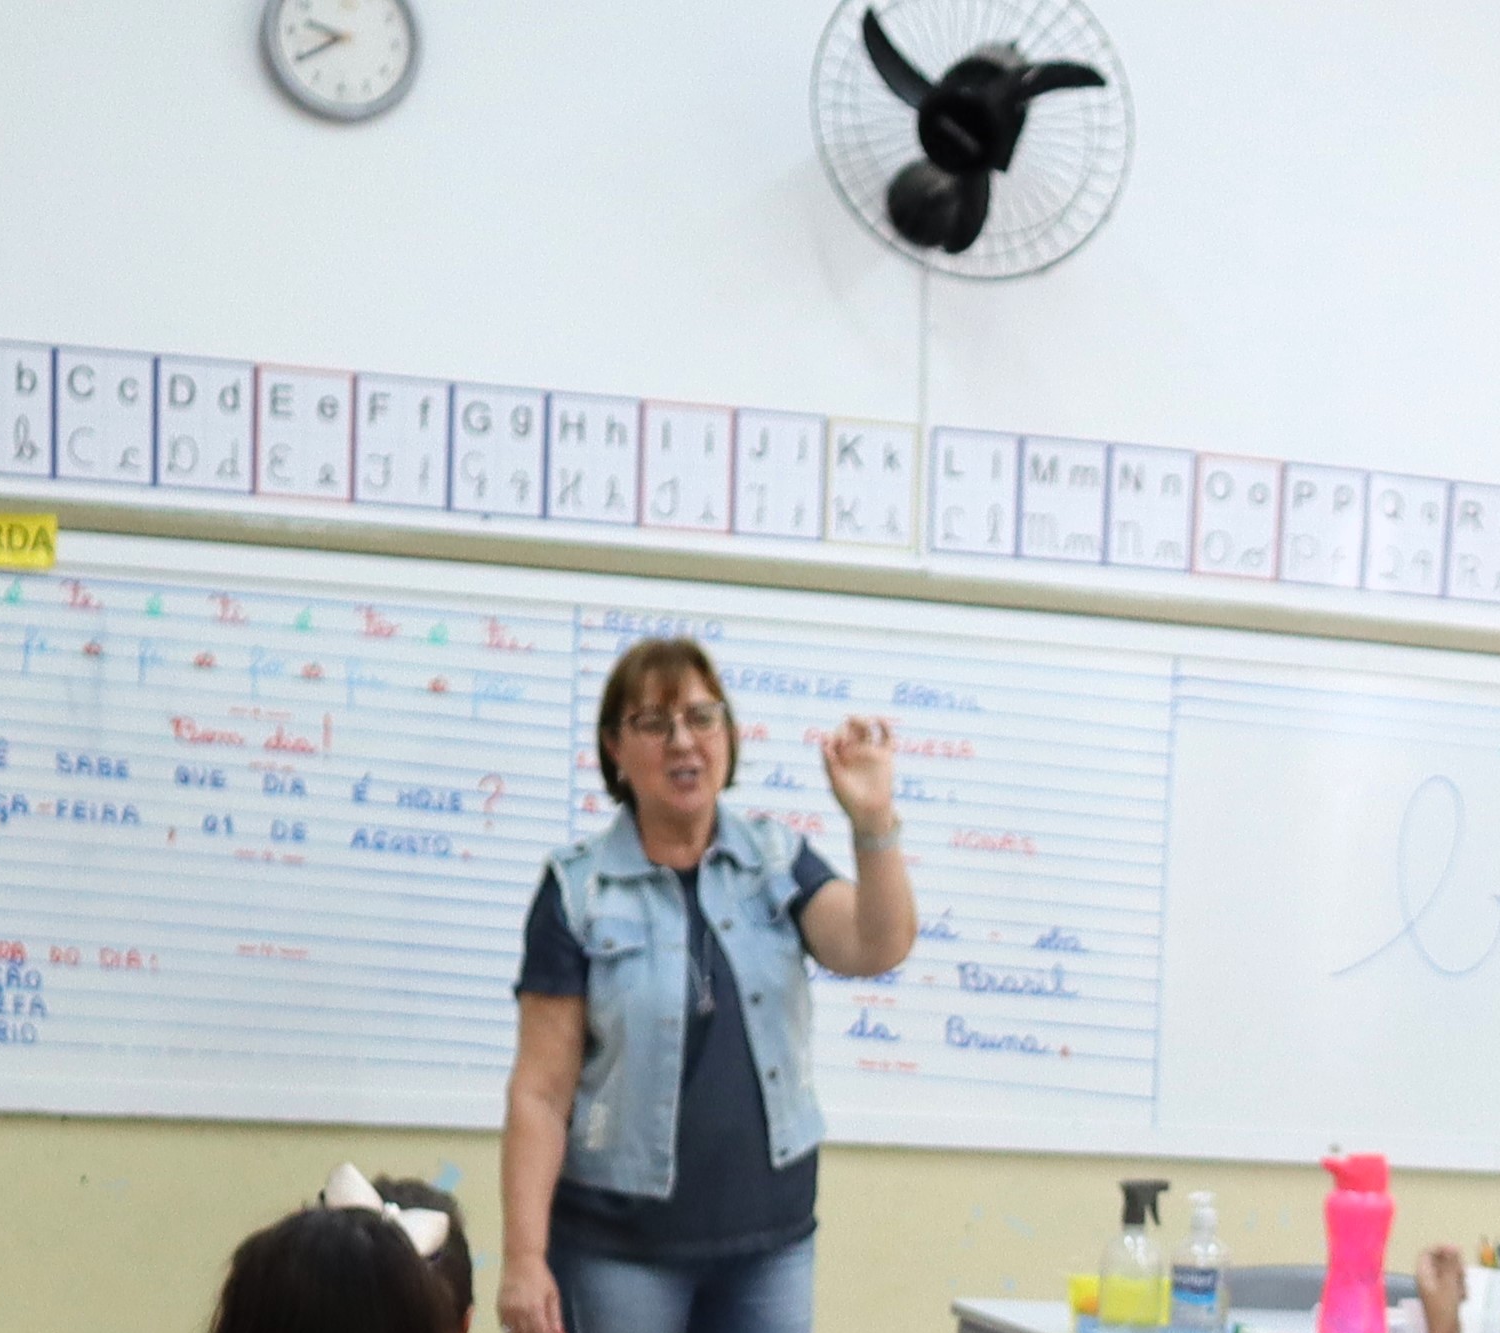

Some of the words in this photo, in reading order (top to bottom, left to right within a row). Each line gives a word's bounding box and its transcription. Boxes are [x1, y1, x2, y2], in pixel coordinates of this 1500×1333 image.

[55, 751, 130, 781] SABE
[175, 763, 227, 790] QUE
[262, 773, 308, 799] DIA
[271, 818, 309, 843] DE
[49, 945, 81, 966] DO
